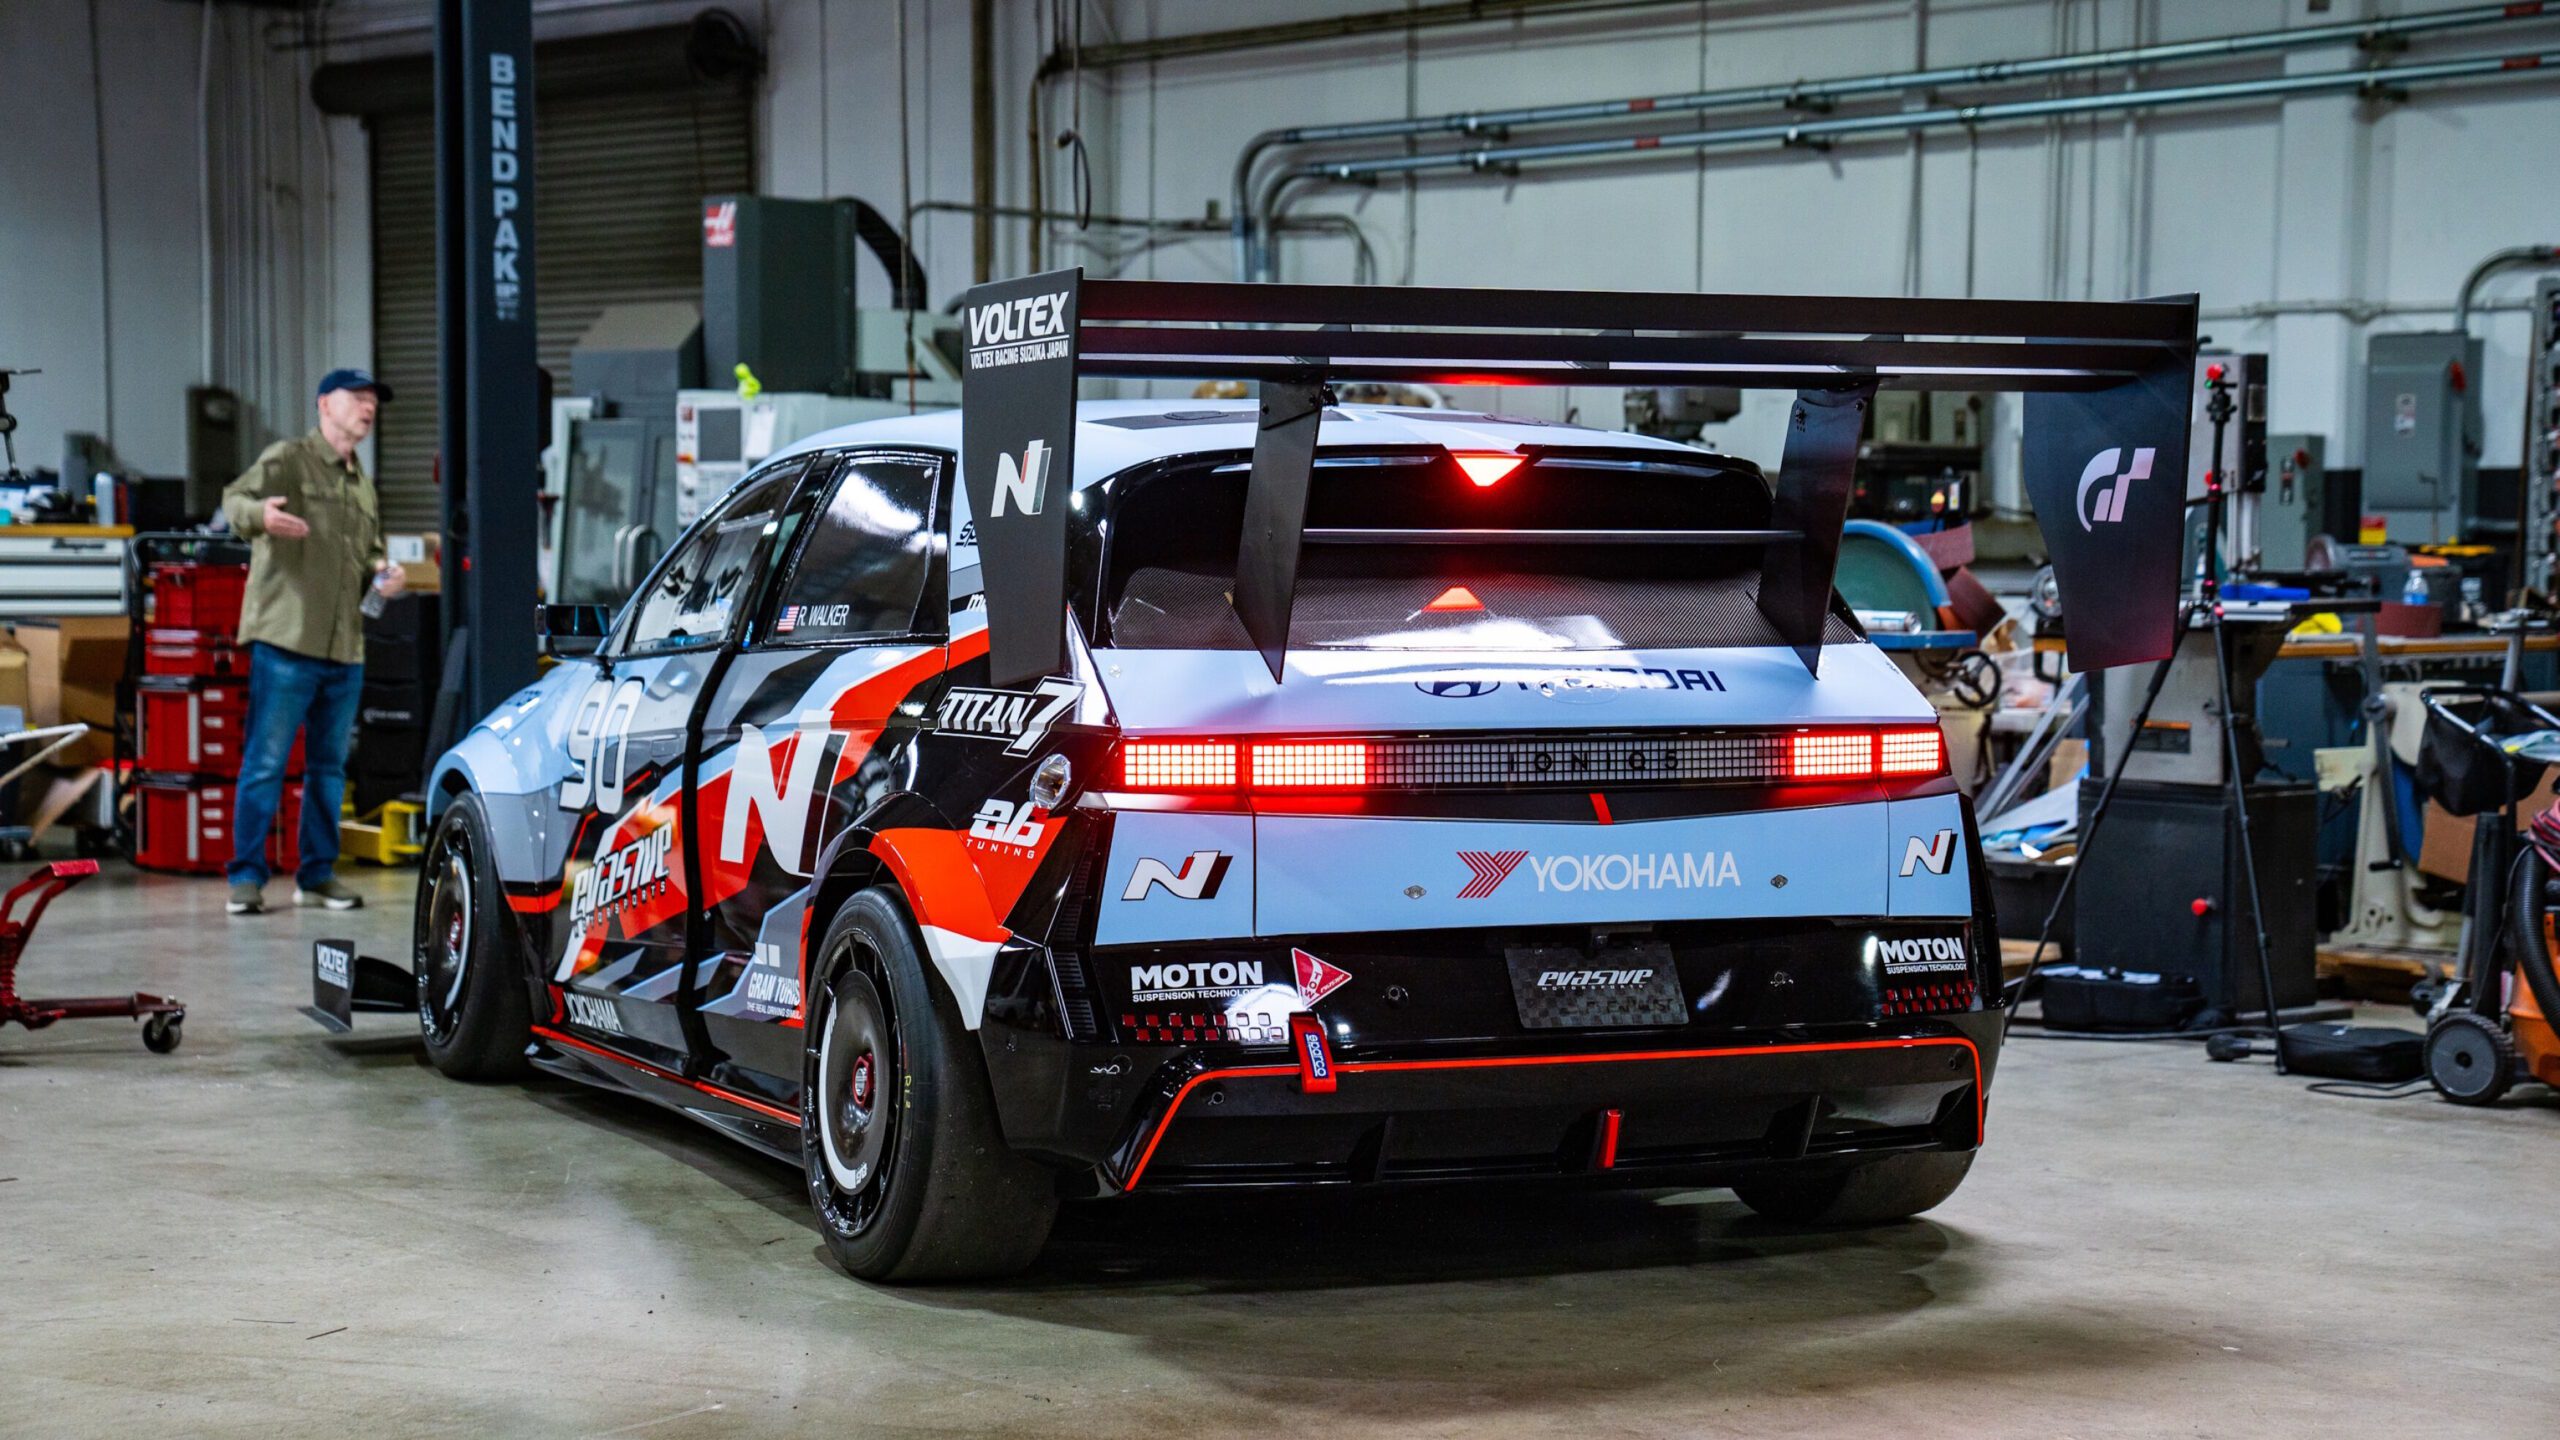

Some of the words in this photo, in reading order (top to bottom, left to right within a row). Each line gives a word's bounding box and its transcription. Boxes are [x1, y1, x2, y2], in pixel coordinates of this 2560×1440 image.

[490, 54, 519, 282] BENDPAK
[969, 291, 1069, 346] VOLTEX
[970, 351, 994, 369] VOLTEX
[995, 347, 1019, 366] RACING
[1020, 343, 1046, 363] SUZUKA
[1047, 340, 1068, 359] JAPAN
[808, 604, 850, 626] WALKER
[559, 677, 644, 815] 90
[1509, 750, 1646, 773] IONIQ
[1664, 750, 1679, 770] 5
[966, 838, 1035, 859] TUNING
[1530, 851, 1741, 892] YOKOHAMA
[317, 943, 349, 976] VOLTEX
[1879, 937, 1965, 963] MOTON
[1131, 961, 1264, 990] MOTON
[1886, 964, 1928, 975] SUSPENSION
[1929, 963, 1967, 972] TECHNOLOGY
[747, 971, 778, 1002] GRAN
[774, 976, 801, 1006] TURIS
[1132, 990, 1196, 1003] SUSPENSION
[1197, 988, 1256, 999] TECHNOLO
[1304, 971, 1321, 999] TOW
